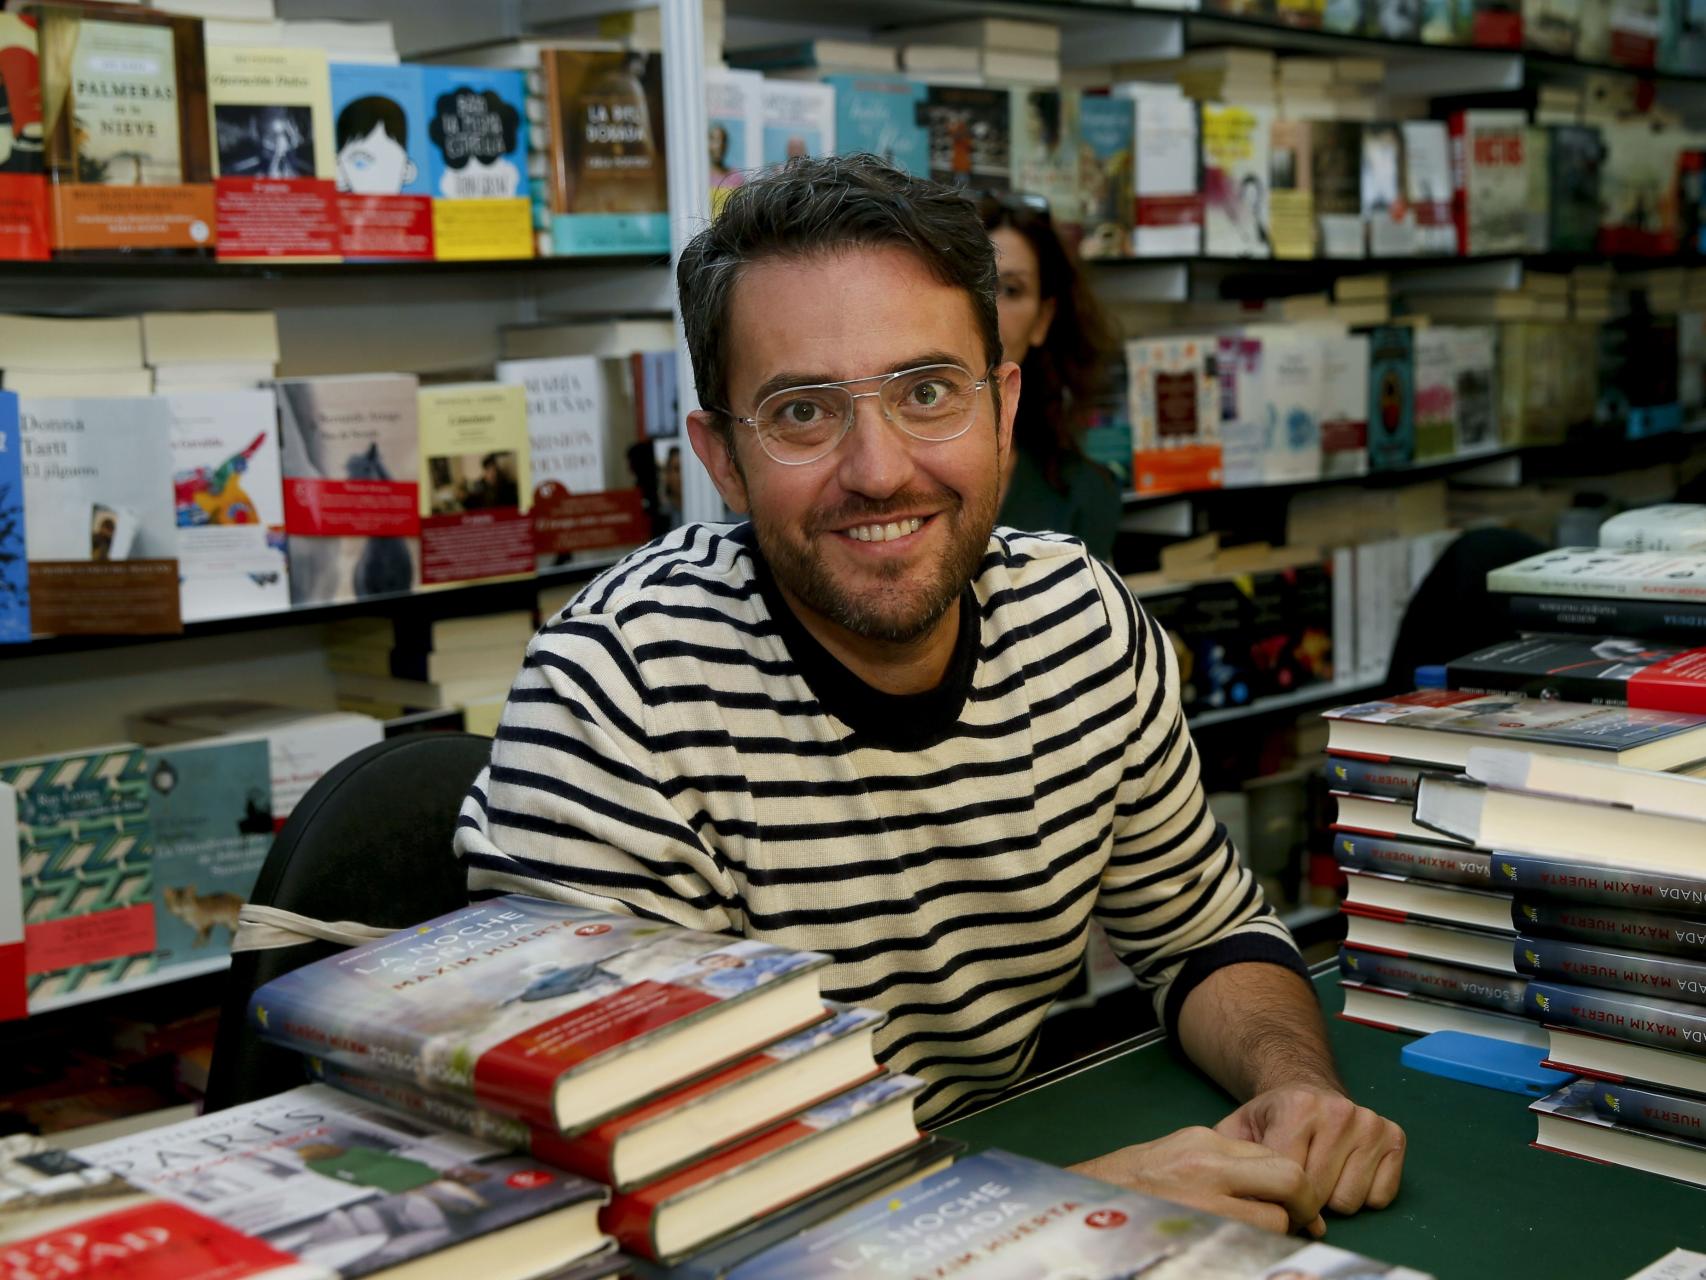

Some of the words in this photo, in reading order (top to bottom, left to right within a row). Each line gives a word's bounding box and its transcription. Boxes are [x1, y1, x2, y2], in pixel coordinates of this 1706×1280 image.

[77, 81, 173, 99] PALMERAS
[1540, 872, 1598, 889] HUERTA
[1559, 914, 1616, 931] HUERTA
[354, 957, 404, 976] LA
[406, 910, 525, 955] NOCHE
[1561, 961, 1618, 978] HUERTA
[1570, 1006, 1625, 1025] HUERTA
[1642, 1105, 1702, 1128] HUERTA
[830, 1242, 887, 1272] LA
